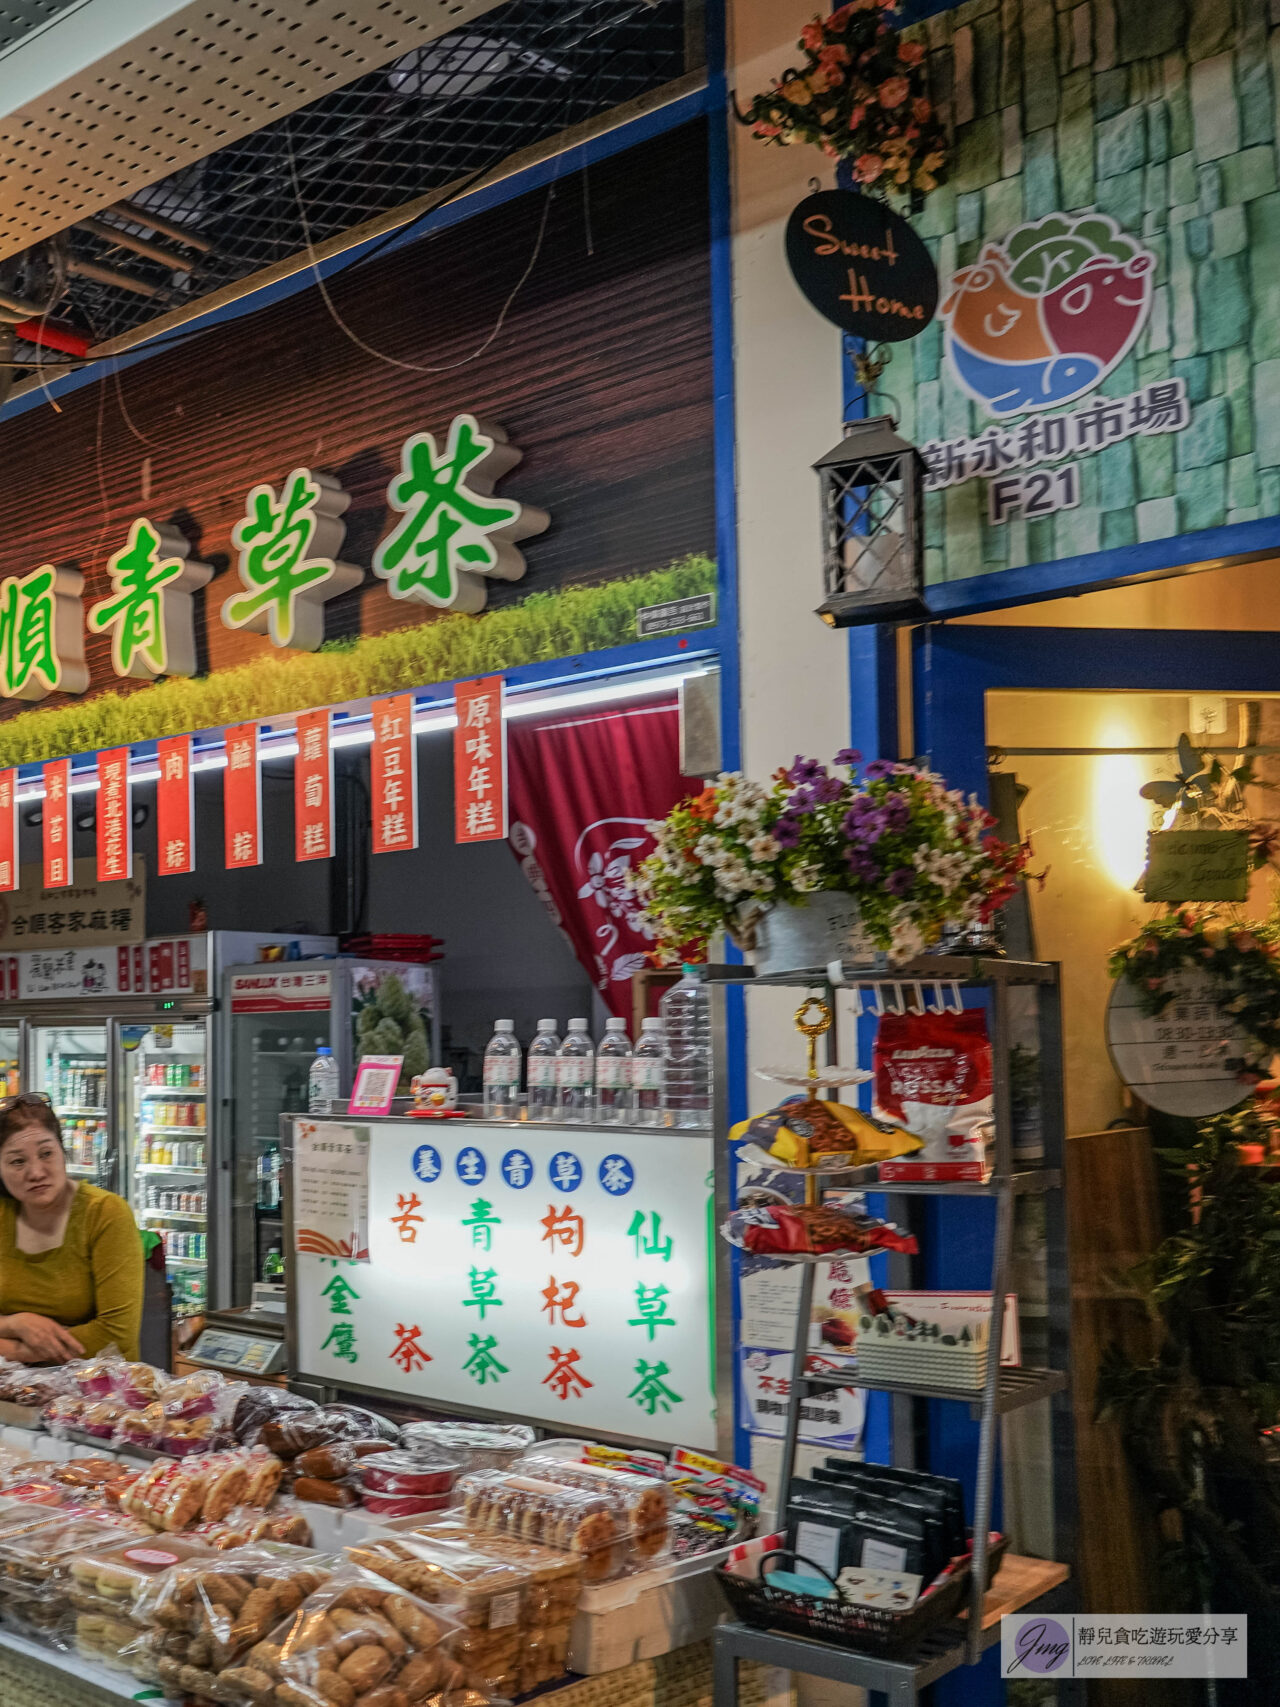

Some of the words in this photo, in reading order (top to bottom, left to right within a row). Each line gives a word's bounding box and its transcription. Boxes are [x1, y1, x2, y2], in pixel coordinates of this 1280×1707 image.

[803, 214, 899, 266] Sweet
[839, 268, 924, 319] Home
[921, 381, 1184, 485] 新永和市場
[992, 465, 1078, 519] F21
[380, 714, 408, 846] 紅豆年糕
[464, 695, 496, 834] 原味年糕
[414, 1148, 633, 1192] 養生青草茶
[461, 1198, 510, 1385] 青草茶
[539, 1204, 594, 1401] 枸杞茶
[626, 1209, 684, 1415] 仙草茶
